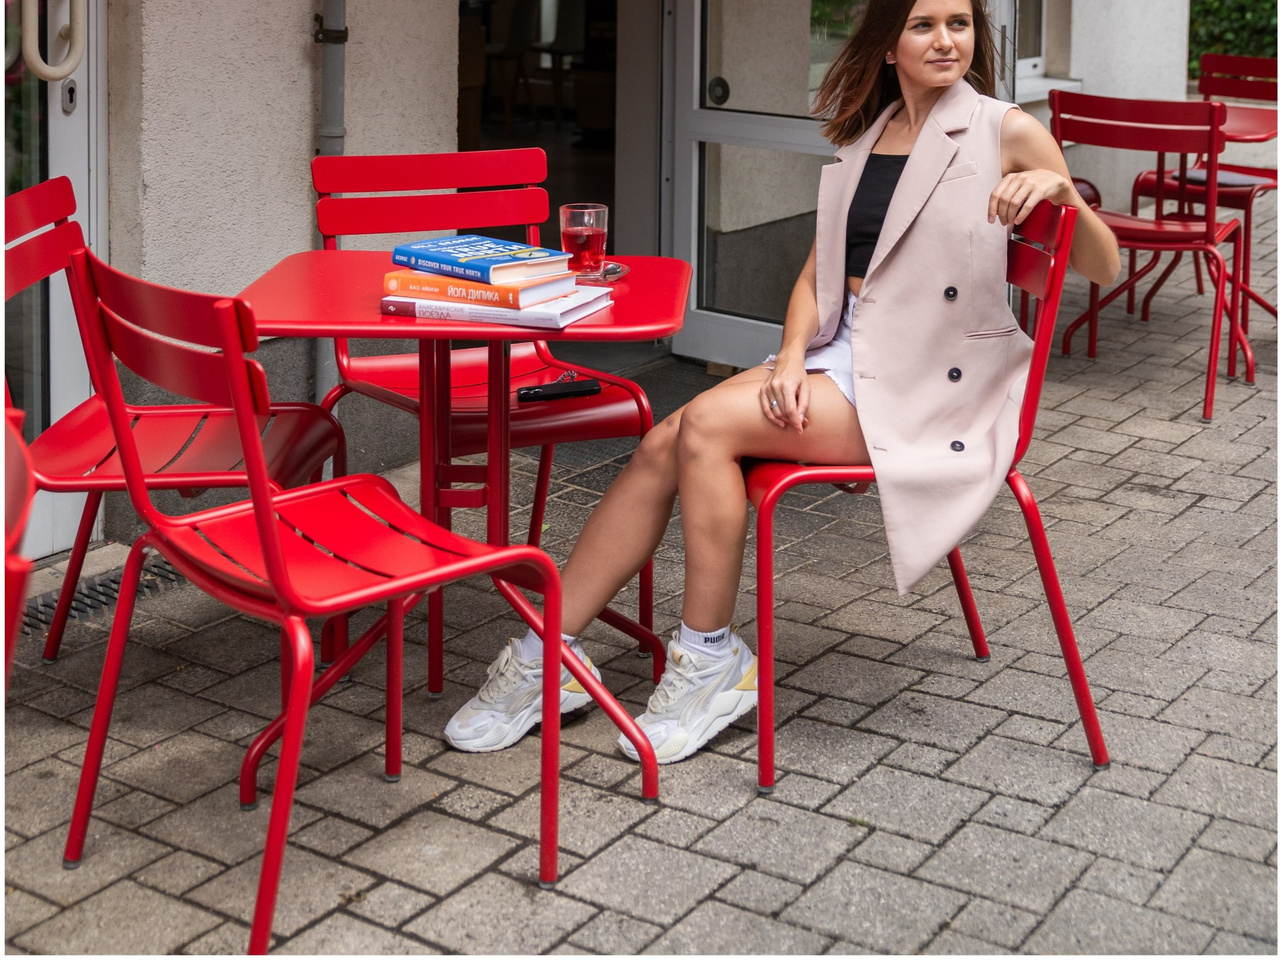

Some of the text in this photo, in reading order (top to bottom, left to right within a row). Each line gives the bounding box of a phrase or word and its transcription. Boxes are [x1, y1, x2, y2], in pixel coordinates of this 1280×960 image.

[418, 259, 481, 277] DISCOVER YOUR TRUE NORTH
[447, 285, 467, 297] ЙОГА
[468, 289, 500, 301] ДИПИКА
[419, 309, 452, 320] ПОЕЗДА
[704, 633, 725, 644] PUMA
